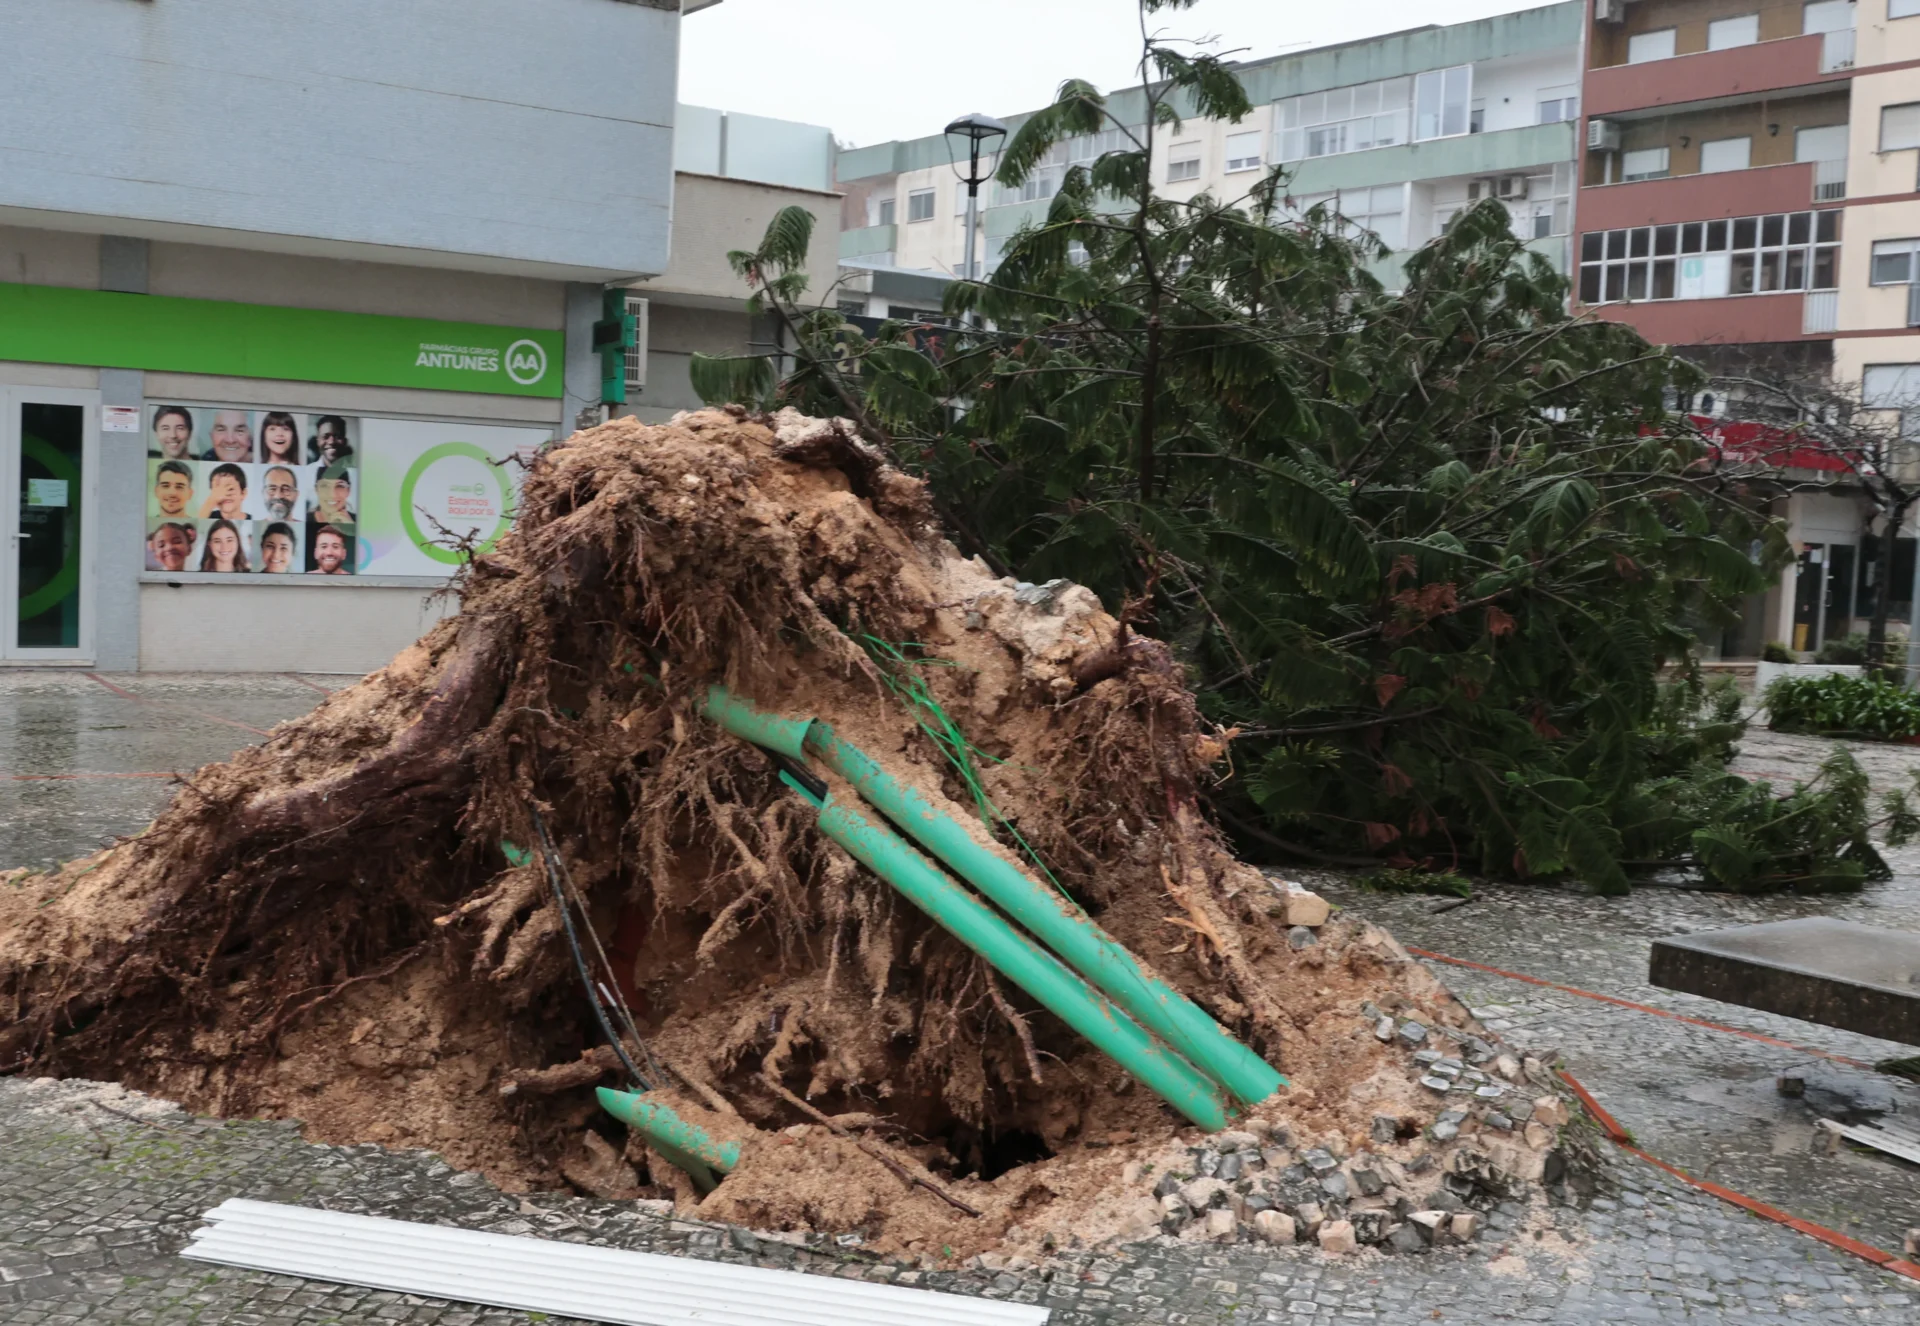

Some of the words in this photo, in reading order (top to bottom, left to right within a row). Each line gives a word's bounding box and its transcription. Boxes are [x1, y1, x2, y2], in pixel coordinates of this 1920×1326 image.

[419, 343, 468, 354] FARMÁCIAS
[469, 347, 500, 357] GRUPO
[415, 352, 499, 372] ANTUNES
[512, 353, 539, 371] AA
[448, 496, 488, 506] Estamos
[448, 507, 466, 515] aqui
[468, 507, 485, 516] por
